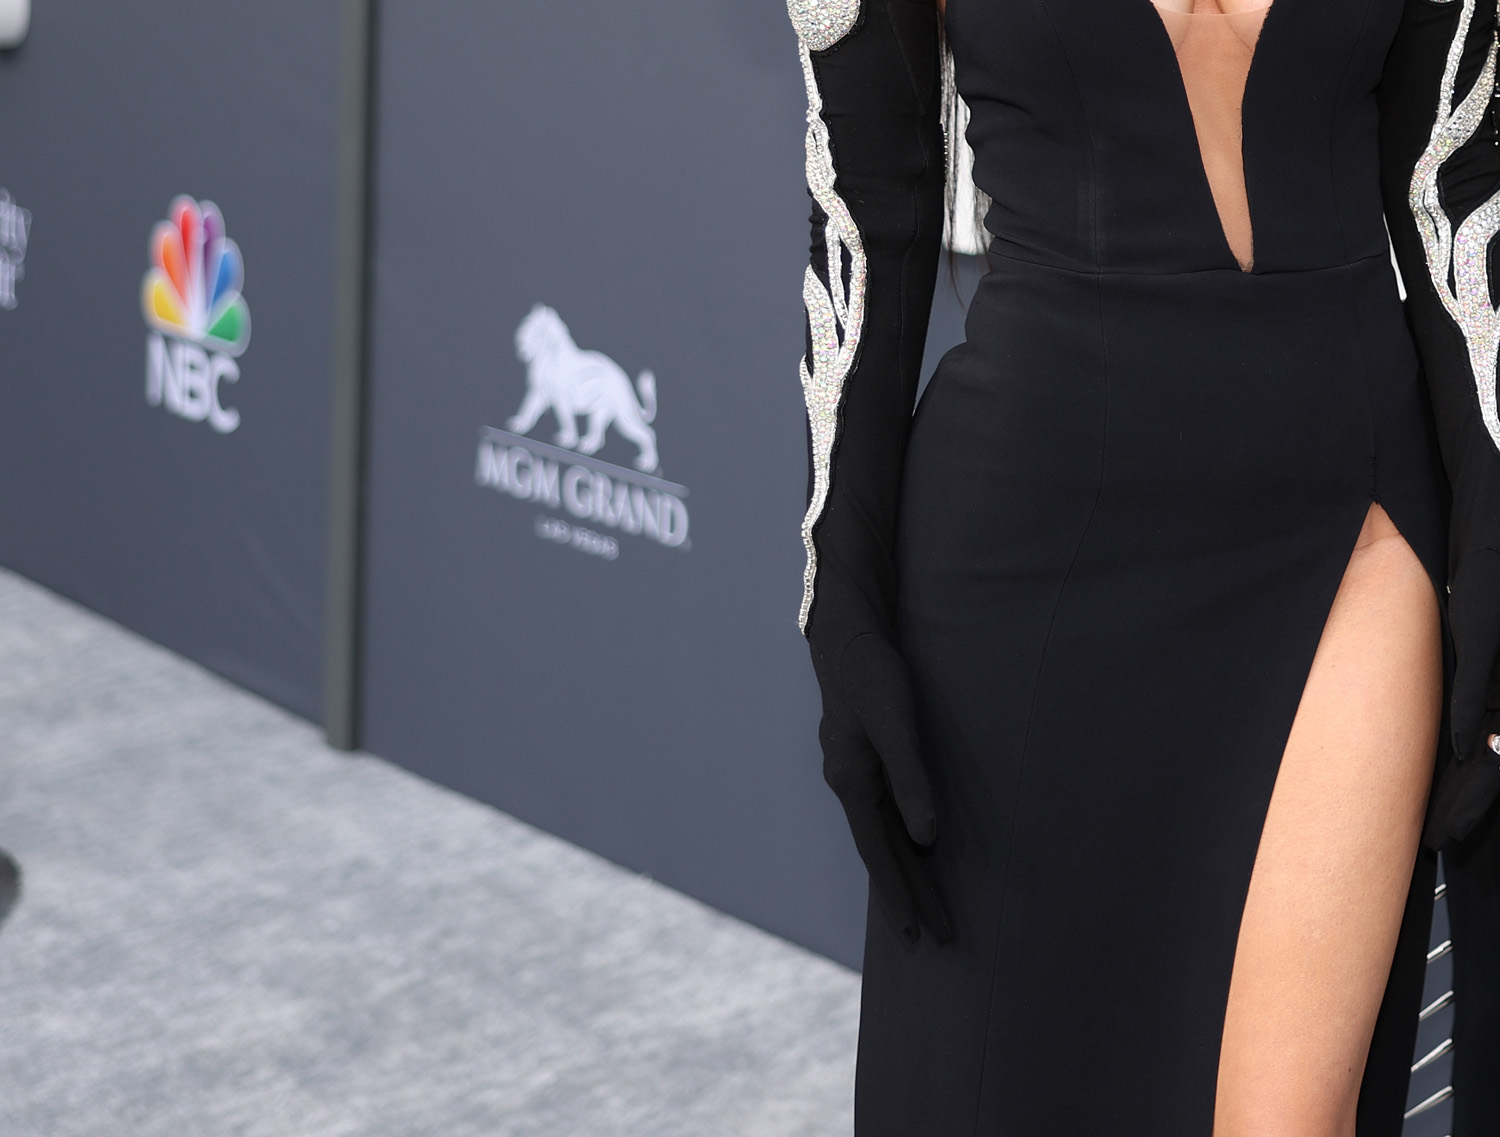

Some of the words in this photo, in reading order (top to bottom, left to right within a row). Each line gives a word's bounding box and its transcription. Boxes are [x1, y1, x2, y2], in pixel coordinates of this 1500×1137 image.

[145, 330, 241, 433] NBC
[475, 440, 561, 509] MGM
[562, 464, 690, 548] GRAND
